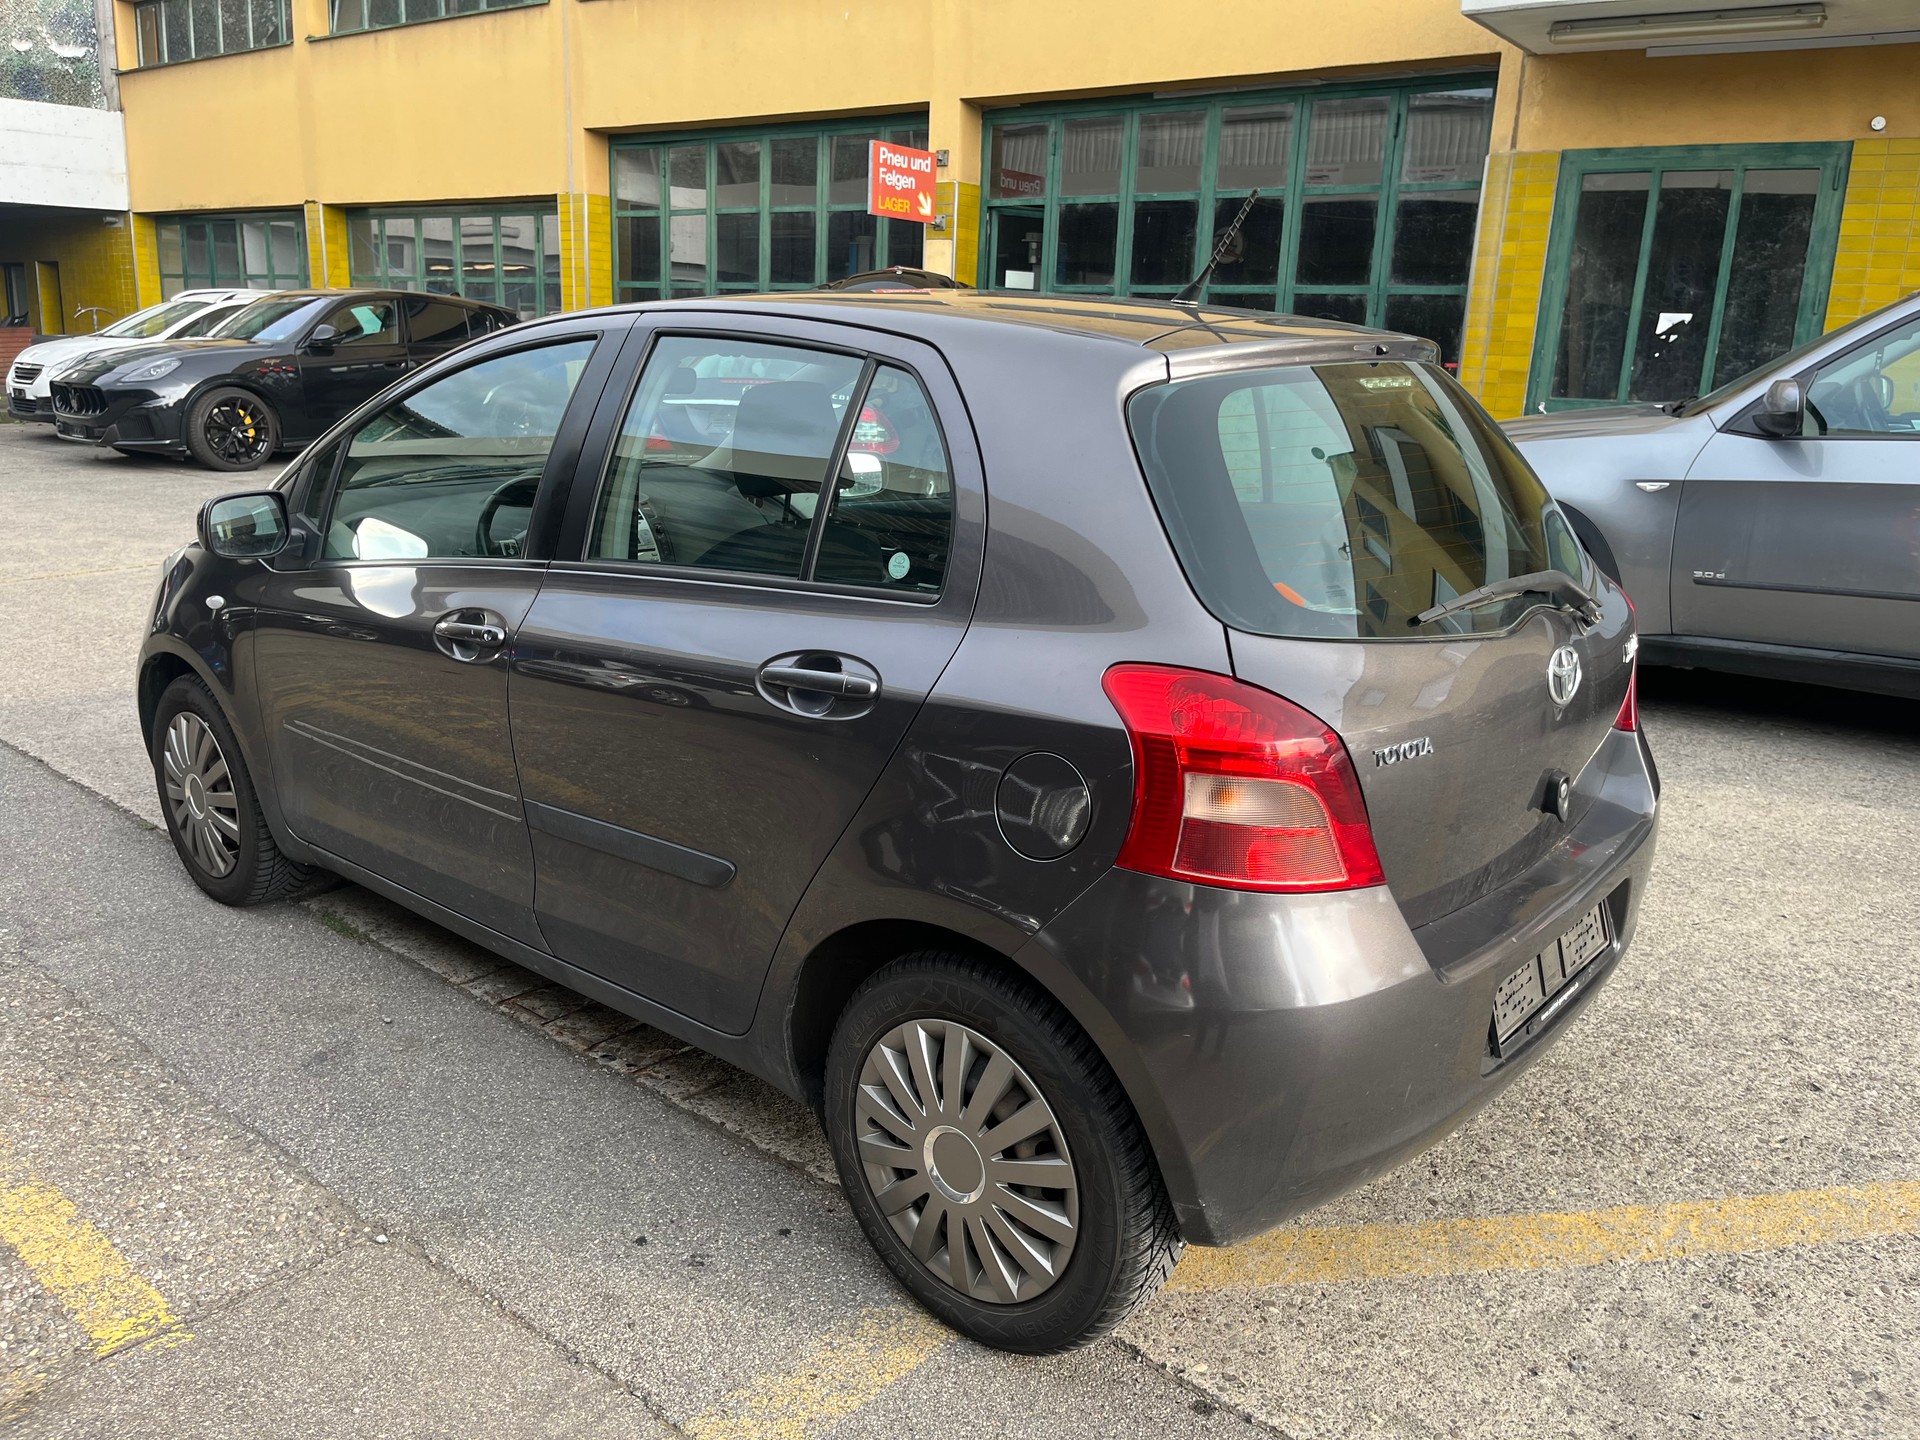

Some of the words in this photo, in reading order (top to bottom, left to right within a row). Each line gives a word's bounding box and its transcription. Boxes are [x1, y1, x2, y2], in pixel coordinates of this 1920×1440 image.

[879, 146, 908, 169] Pneu
[910, 155, 931, 173] und
[879, 167, 916, 191] Felgen
[878, 195, 911, 214] LAGER
[1372, 736, 1434, 767] TOYOTA
